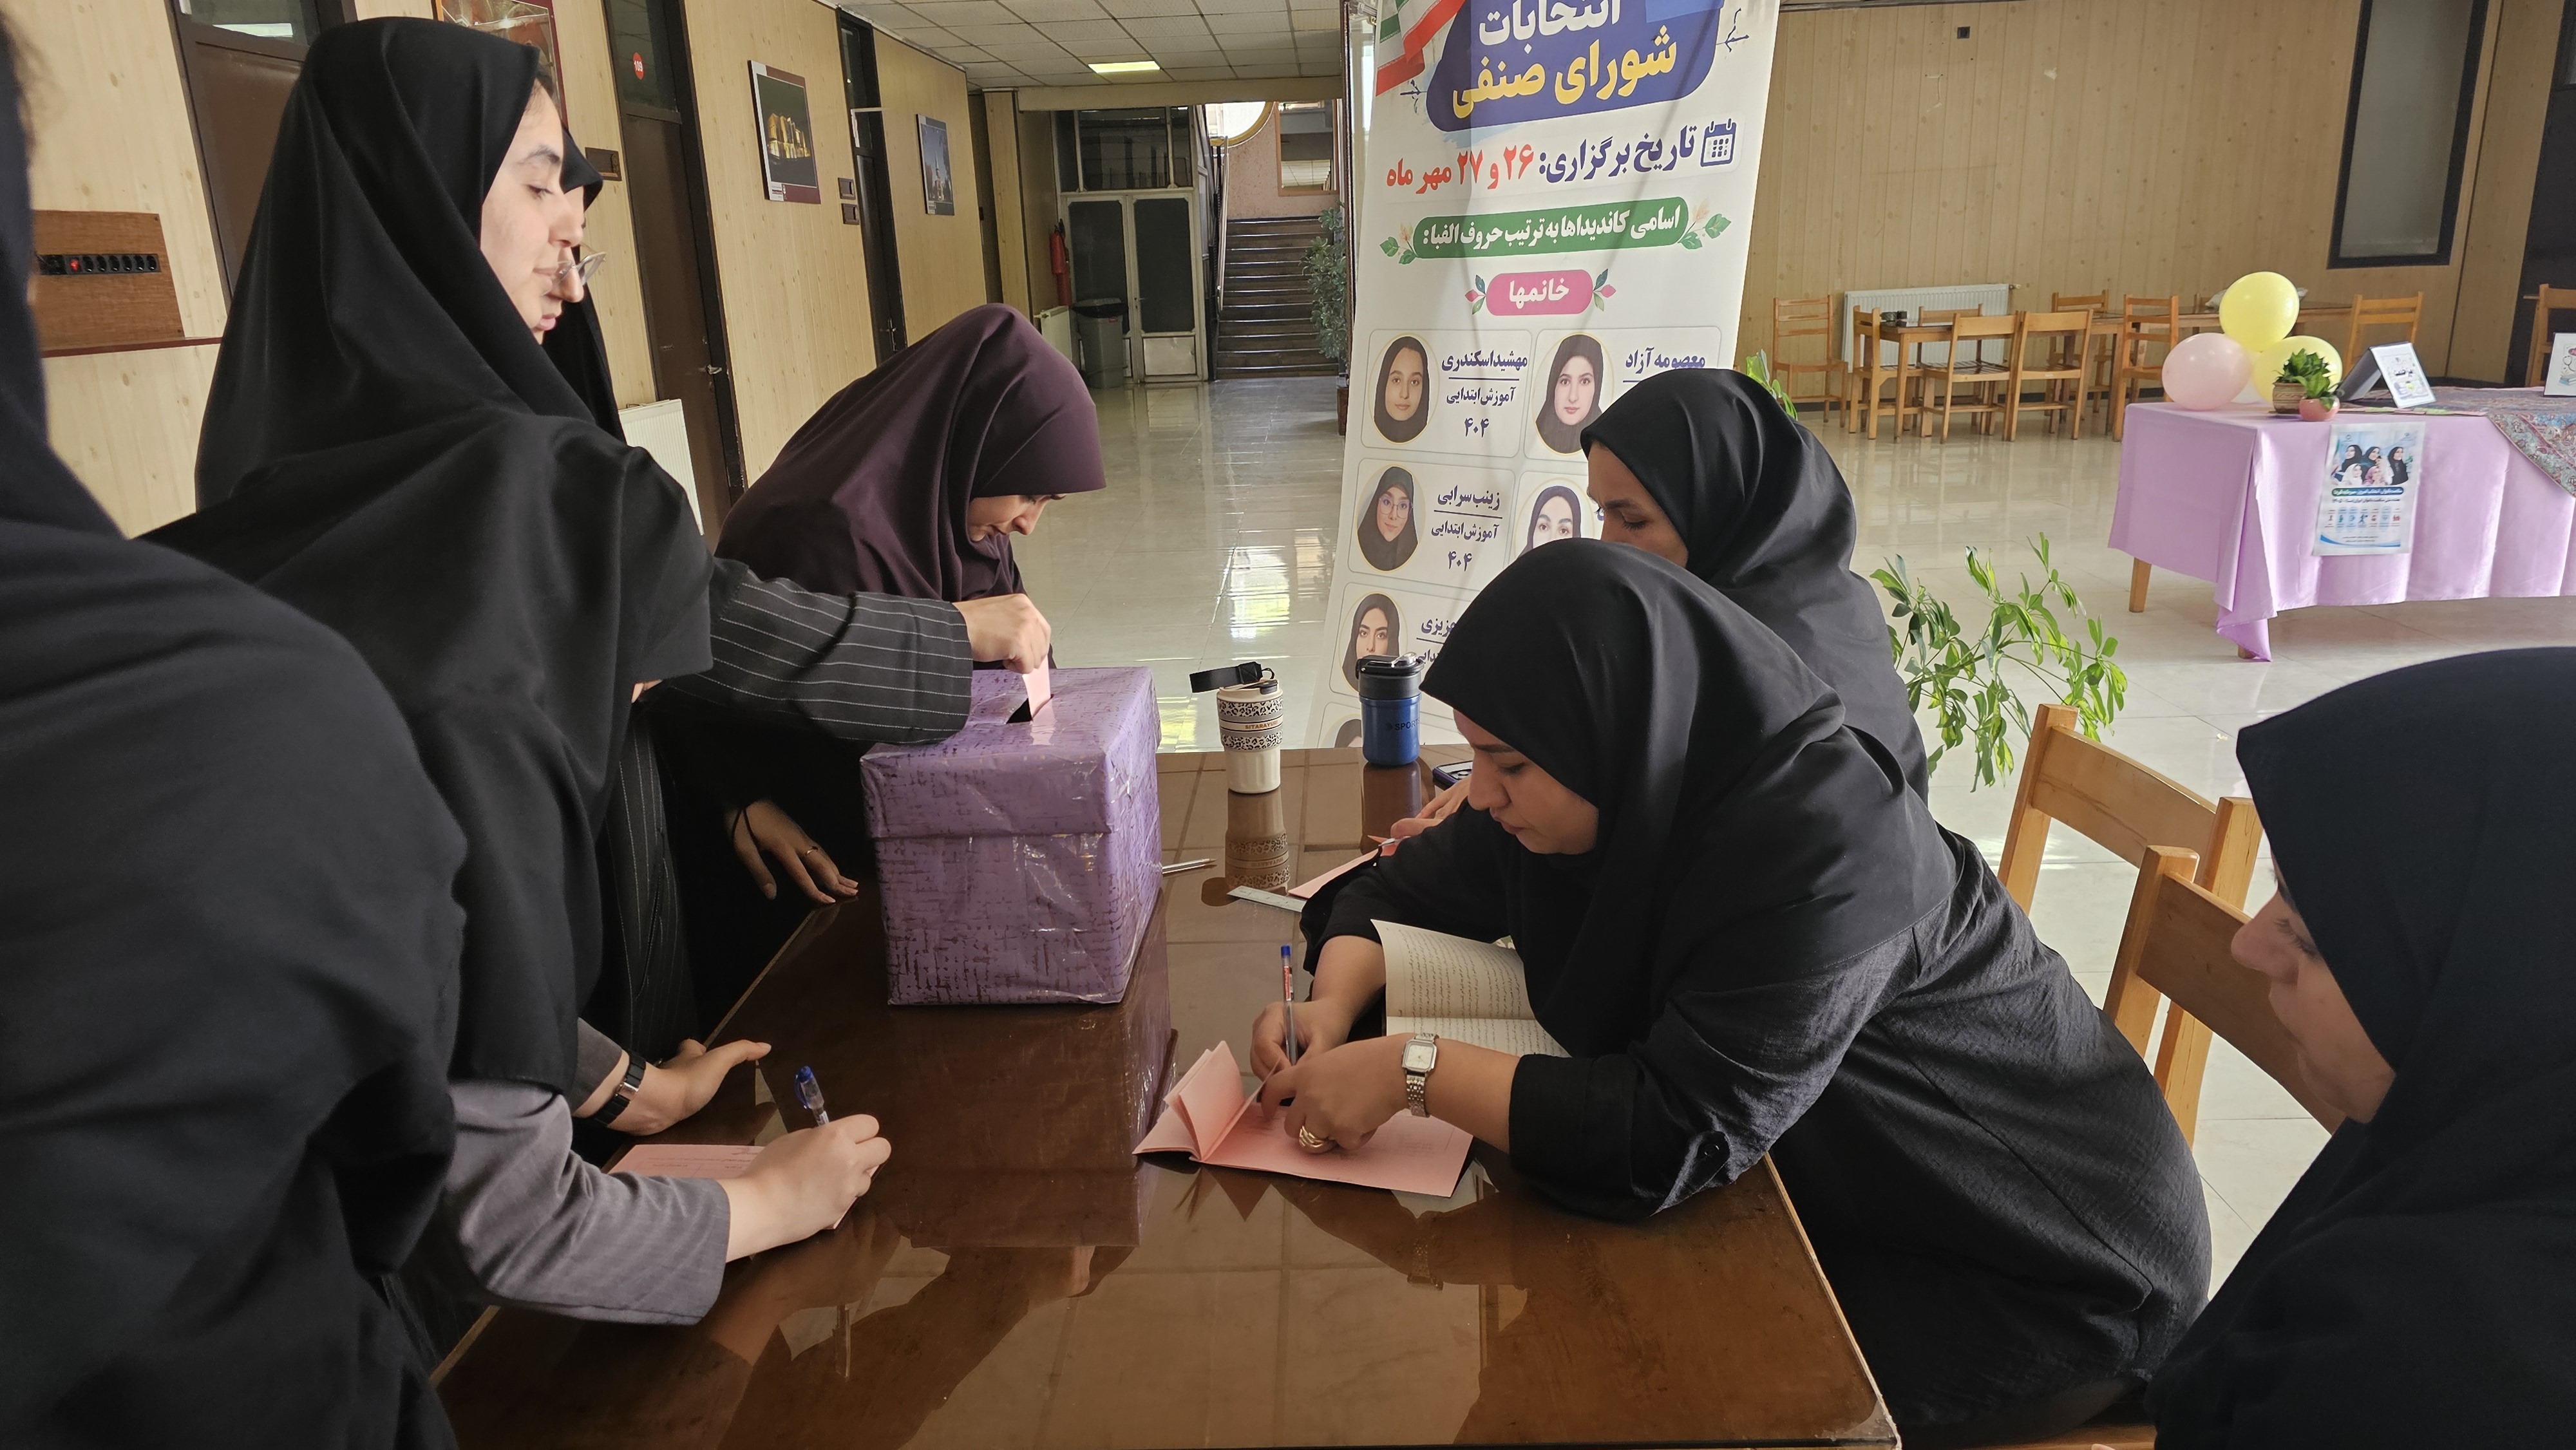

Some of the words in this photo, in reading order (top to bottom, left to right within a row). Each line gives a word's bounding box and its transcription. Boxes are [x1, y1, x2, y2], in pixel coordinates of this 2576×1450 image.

[1479, 0, 1621, 54] انتخابات
[1554, 24, 1677, 105] شورای
[1452, 55, 1546, 119] صنفی
[1503, 144, 1535, 180] ۲۶
[1539, 135, 1631, 184] برگزاری:
[1633, 124, 1698, 173] تاریخ
[1386, 157, 1414, 187] ماه
[1415, 165, 1452, 194] مهر
[1457, 149, 1484, 185] ۲۷
[1487, 162, 1499, 190] و
[1423, 222, 1460, 250] الفبا:
[1460, 221, 1504, 250] حروف
[1504, 218, 1546, 247] ترتیب
[1545, 221, 1559, 244] به
[1560, 209, 1631, 241] کاندیداها
[1630, 204, 1681, 240] اسامی
[1509, 277, 1570, 310] خانمها
[1441, 350, 1493, 372] اسکندری
[1493, 350, 1528, 372] مهشید
[1625, 346, 1655, 375] آزاد
[1654, 353, 1706, 369] معصومه
[1446, 386, 1481, 404] ابتدایی
[1481, 386, 1517, 406] آموزش
[1464, 417, 1490, 438] ۴۰۴
[1437, 484, 1472, 507] سرابی
[1472, 490, 1501, 511] زینب
[1431, 520, 1464, 536] ابتدایی
[1464, 523, 1500, 542] آموزش
[1448, 551, 1473, 572] ۴۰۴
